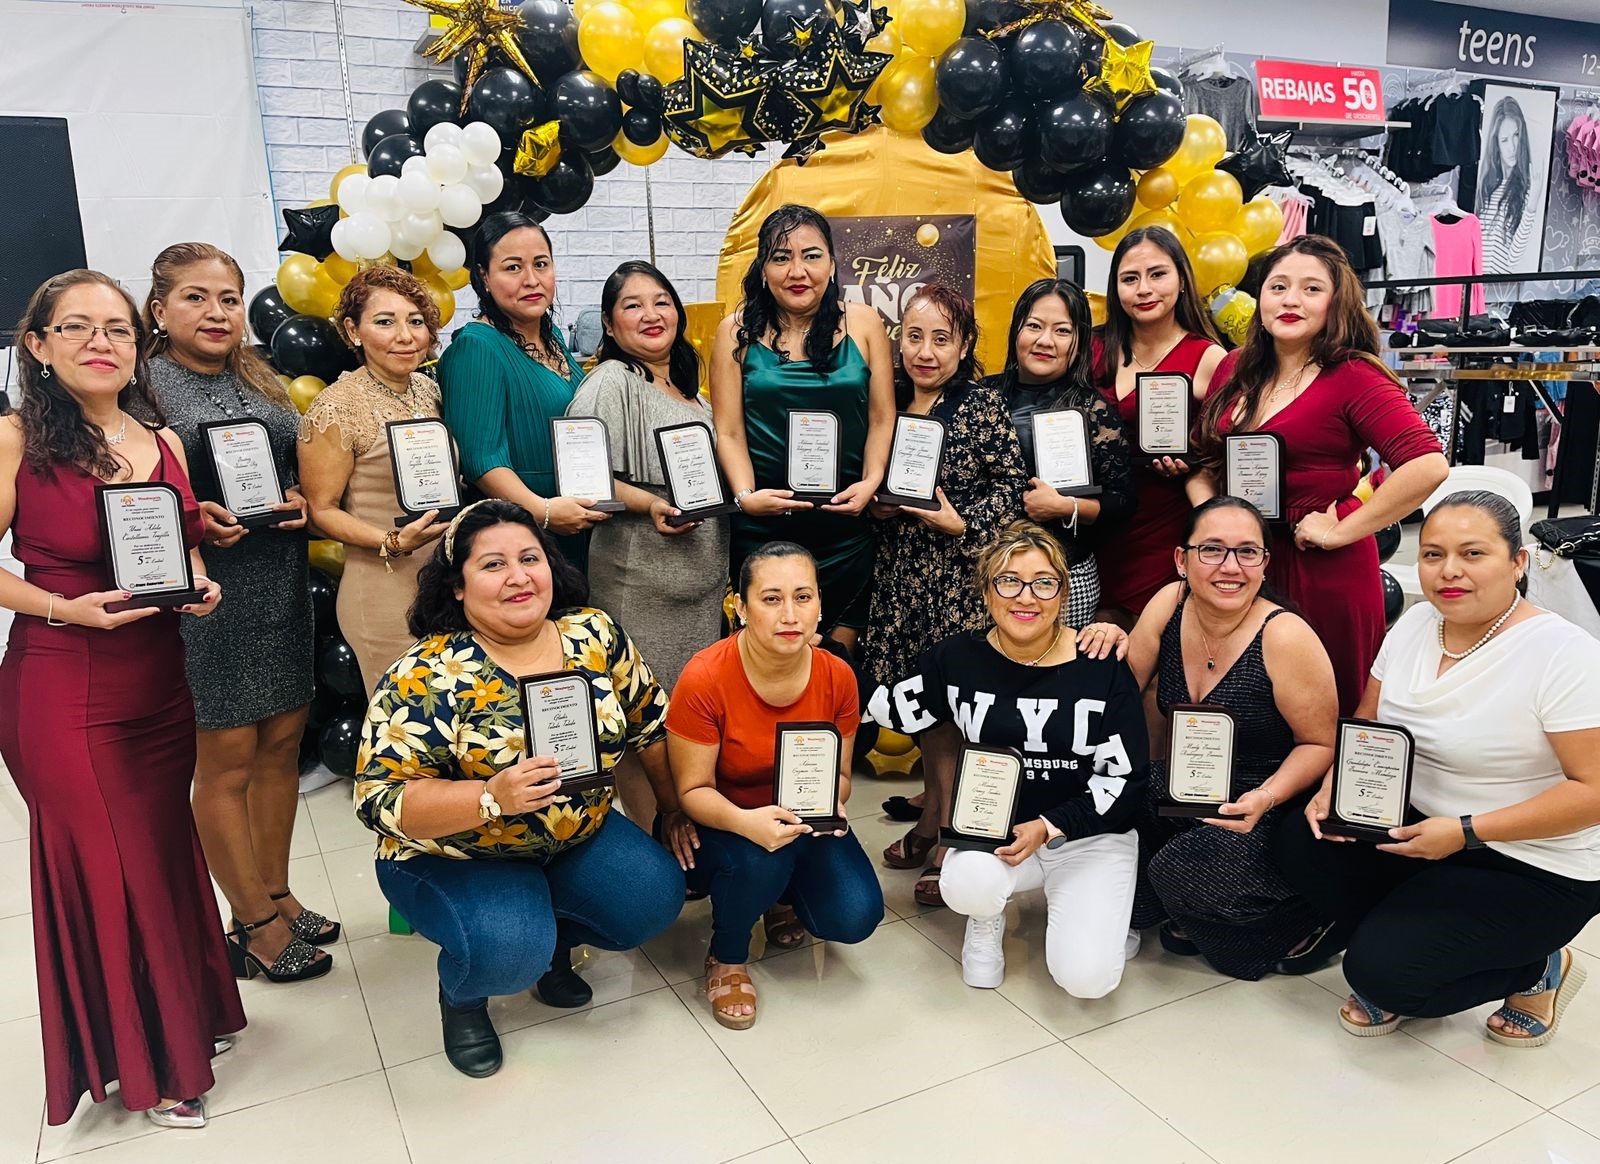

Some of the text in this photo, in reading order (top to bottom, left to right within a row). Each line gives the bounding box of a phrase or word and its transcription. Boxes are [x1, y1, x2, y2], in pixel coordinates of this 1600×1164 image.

[1458, 20, 1537, 68] teens
[1260, 77, 1336, 106] REBAJAS
[852, 255, 921, 287] Feliz
[242, 483, 246, 491] 5
[419, 479, 423, 487] 5
[138, 556, 143, 565] 5
[554, 744, 559, 754] 5
[1190, 770, 1196, 778] 5
[797, 786, 803, 794] 5
[1358, 788, 1365, 797] 5
